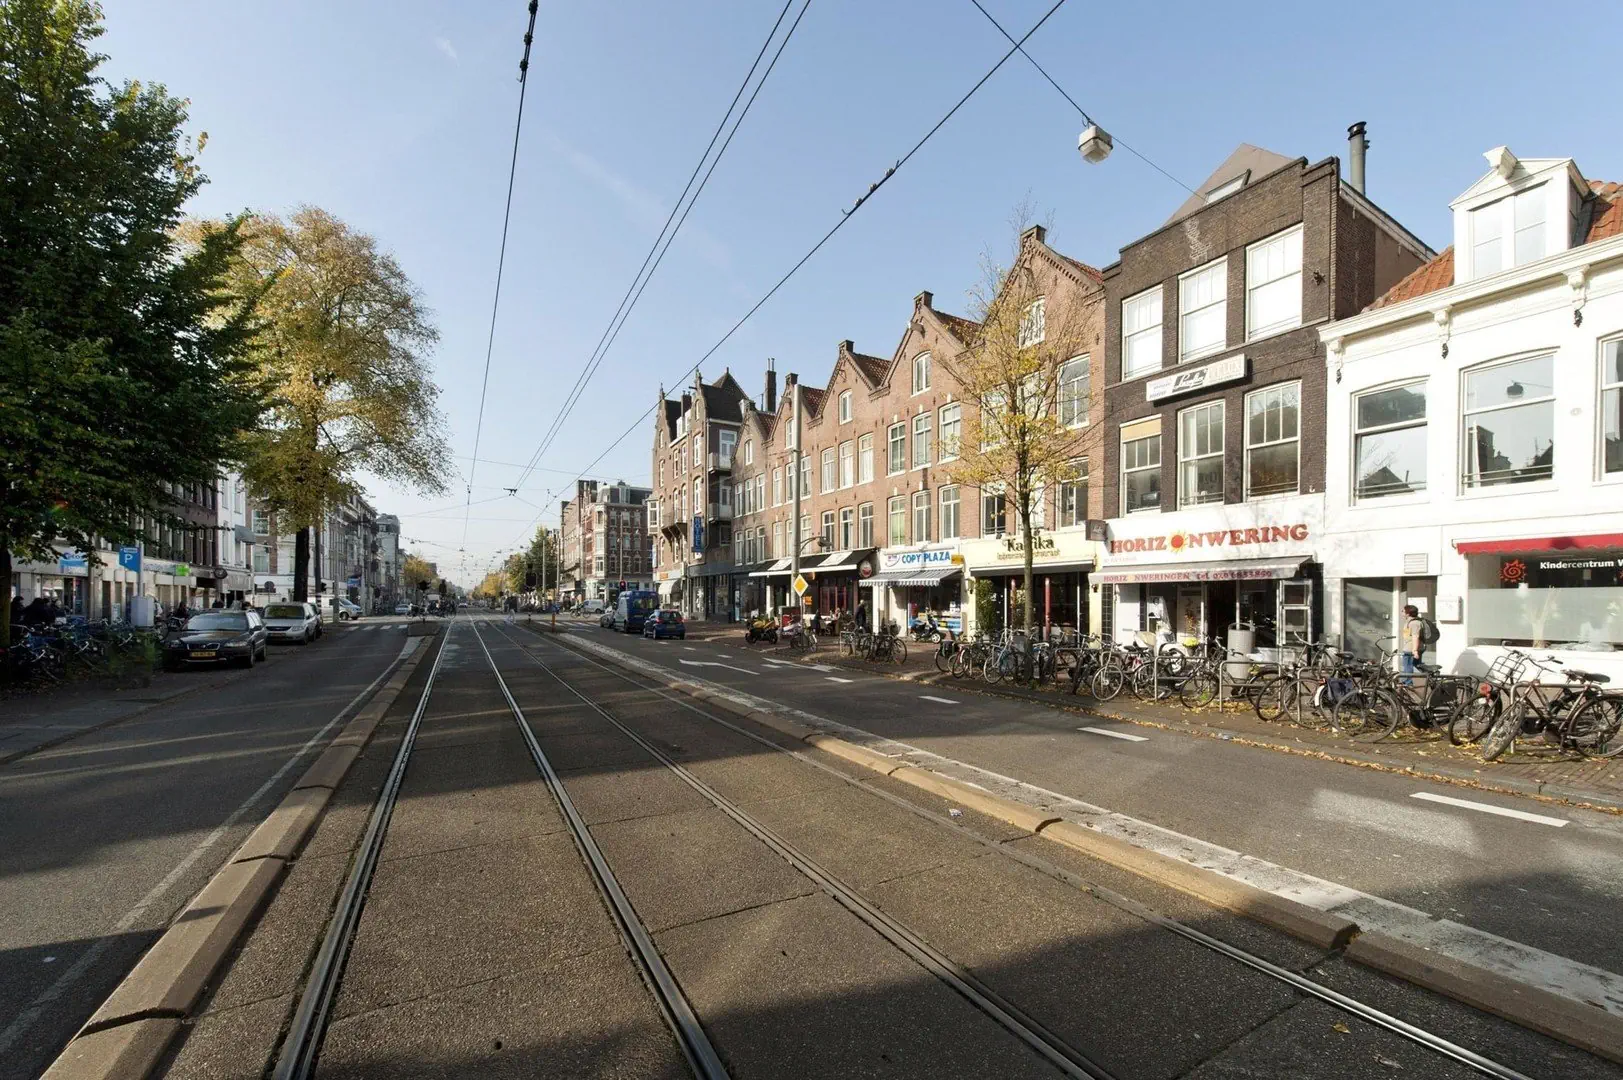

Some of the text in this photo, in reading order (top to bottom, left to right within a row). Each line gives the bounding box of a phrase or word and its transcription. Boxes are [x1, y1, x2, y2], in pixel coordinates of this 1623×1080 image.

[124, 553, 133, 564] P
[901, 553, 922, 563] COPY
[923, 551, 951, 562] PLAZA
[1539, 560, 1614, 569] Kindercentrum
